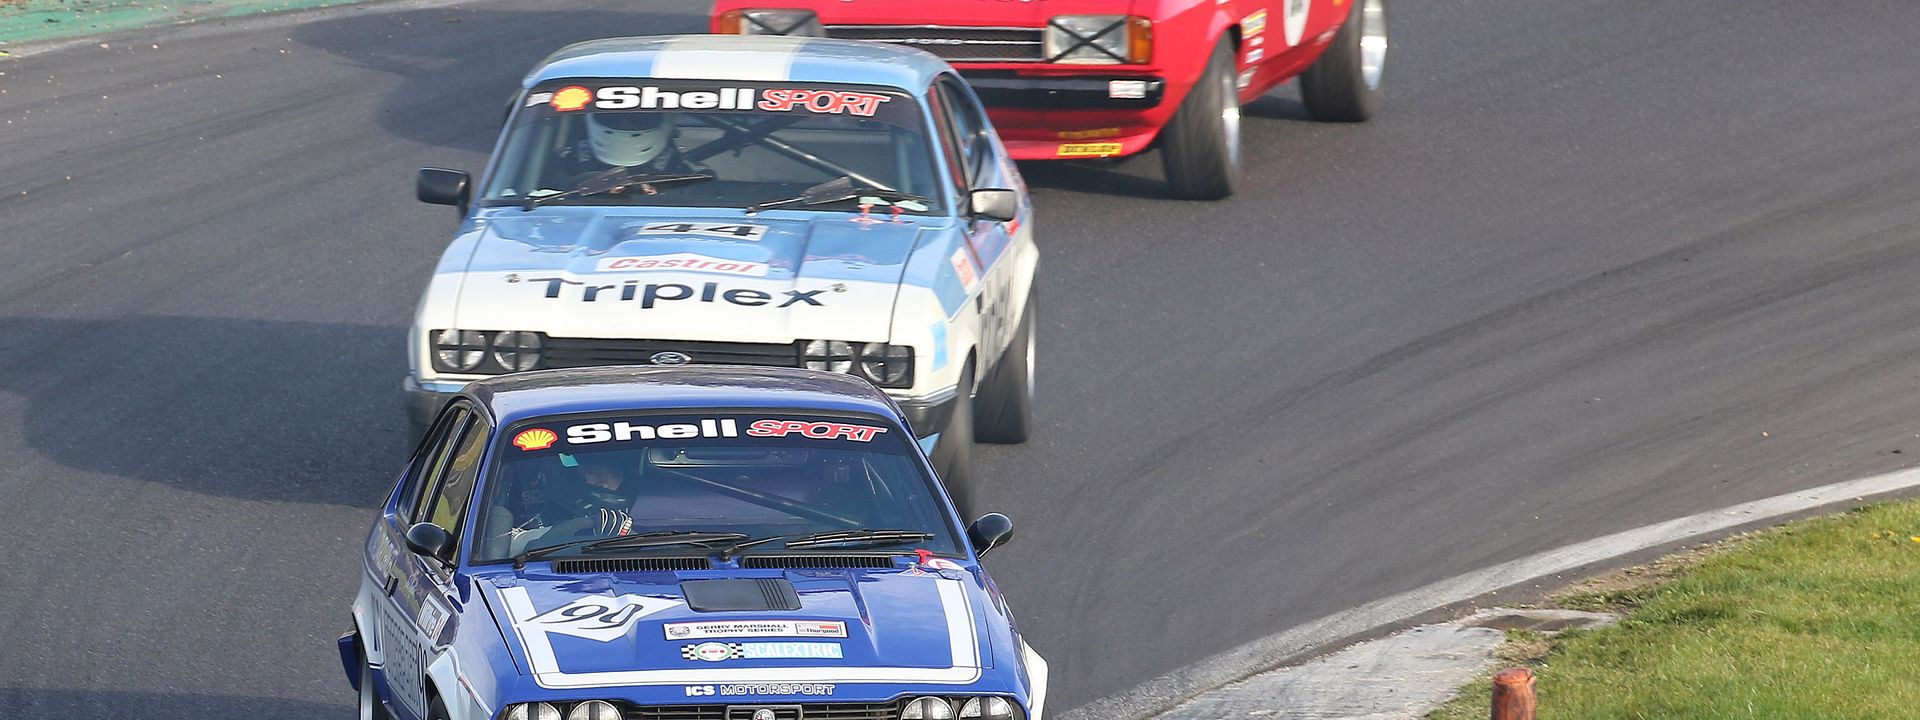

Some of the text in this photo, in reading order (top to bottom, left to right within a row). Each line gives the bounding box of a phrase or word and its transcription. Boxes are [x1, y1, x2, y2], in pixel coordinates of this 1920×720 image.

[595, 86, 891, 117] Shell SPORT
[645, 223, 759, 237] 44
[608, 258, 758, 273] Castrol
[528, 277, 825, 309] Triplex
[565, 418, 889, 444] Shell SPORT
[745, 642, 839, 658] SCALEXTRIC
[685, 683, 836, 697] ICS MOTORSPORT
